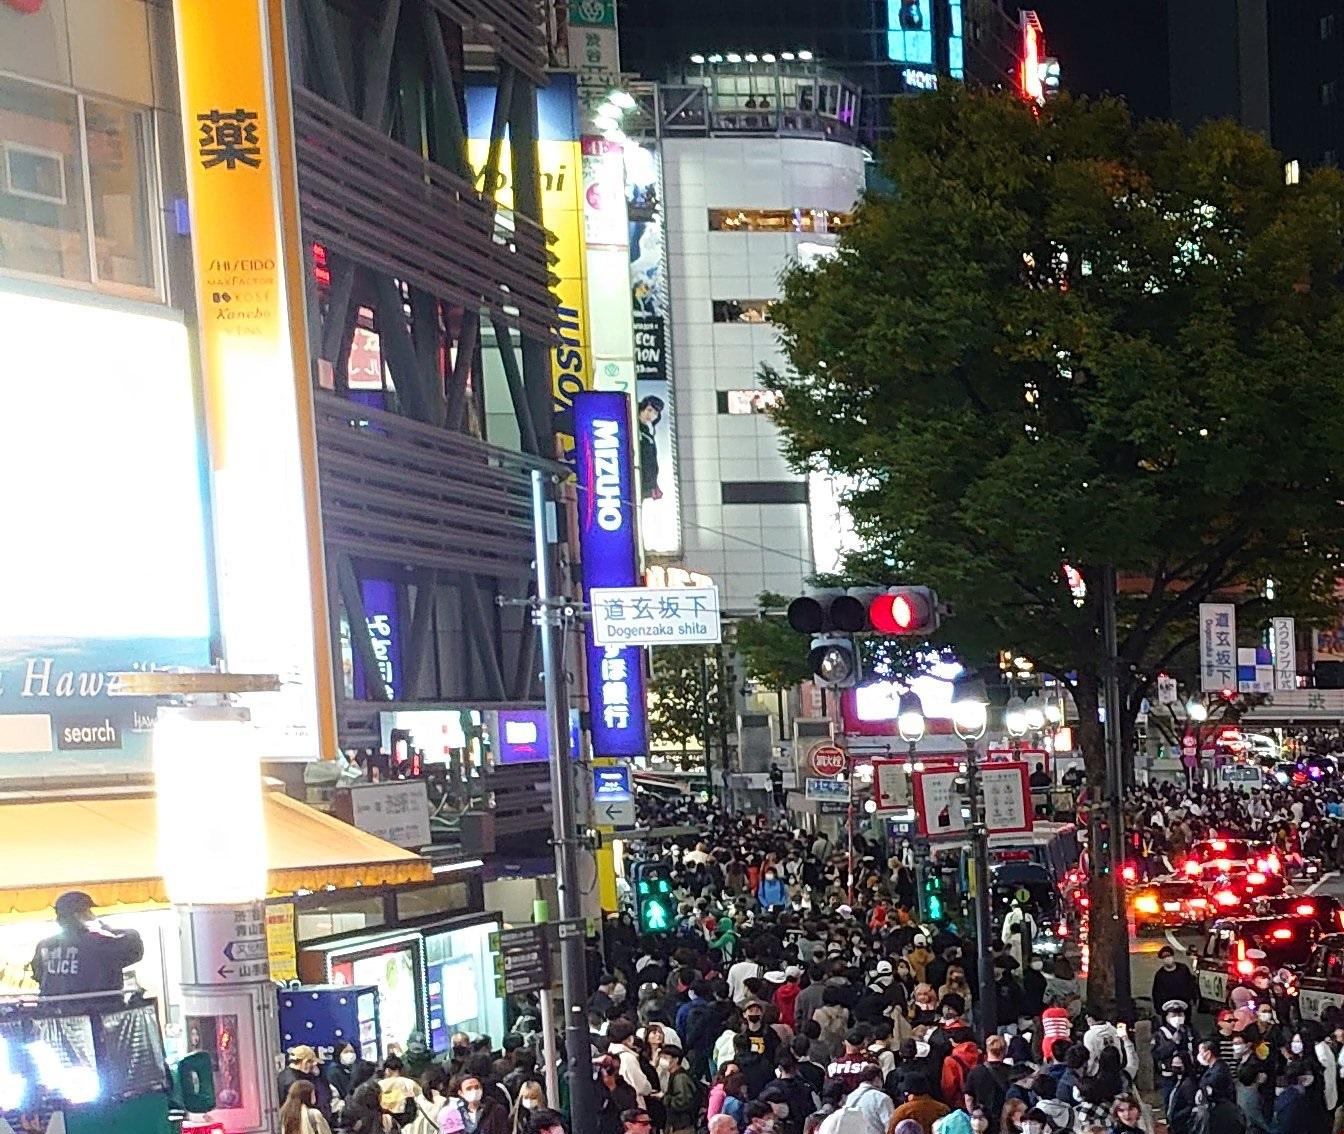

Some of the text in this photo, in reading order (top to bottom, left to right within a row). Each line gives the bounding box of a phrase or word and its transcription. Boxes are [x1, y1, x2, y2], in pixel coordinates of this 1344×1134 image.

[197, 108, 261, 170] 薬
[208, 259, 275, 272] SHISEIDO
[592, 419, 622, 531] MIZUHO
[604, 596, 707, 621] 道玄坂下
[607, 622, 707, 637] Dogenzaka shita
[1215, 612, 1231, 685] 道玄坂下
[64, 719, 116, 743] search
[816, 754, 842, 767] 消火栓
